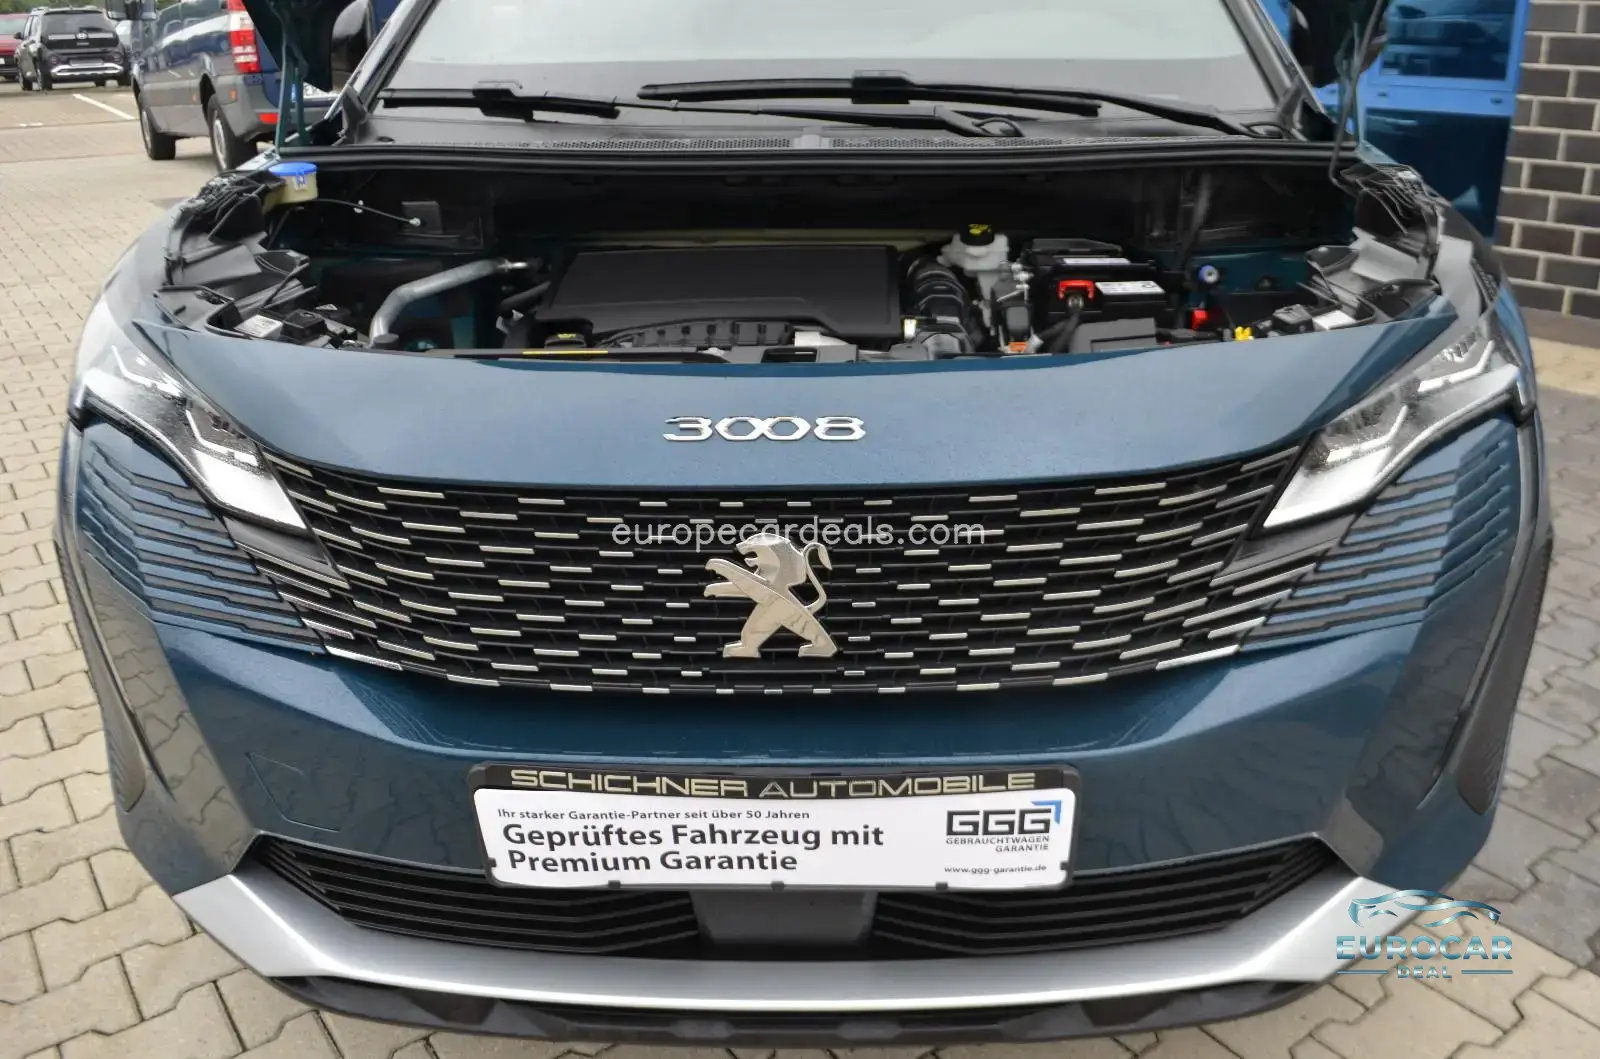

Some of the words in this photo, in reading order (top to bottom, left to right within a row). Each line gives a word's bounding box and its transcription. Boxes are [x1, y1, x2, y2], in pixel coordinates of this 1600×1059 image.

[662, 415, 867, 442] 3008
[511, 769, 748, 797] SCHICHNER
[759, 772, 1036, 798] AUTOMOBILE
[498, 809, 516, 819] Ihr
[519, 809, 565, 820] starker
[568, 810, 680, 820] Garantie-Partner
[685, 810, 708, 819] seit
[711, 809, 742, 819] über
[746, 810, 762, 819] 50
[764, 810, 810, 819] Jahren
[946, 808, 1052, 836] GGG
[503, 823, 663, 851] Geprüftes
[672, 823, 820, 851] Fahrzeug
[831, 824, 884, 846] mit
[946, 835, 1050, 845] GEBRAUCHTWAGEN
[995, 844, 1049, 853] GARANTIE
[508, 850, 651, 873] Premium
[660, 850, 798, 871] Garantie
[944, 863, 1047, 875] www.ggg-garantie.de
